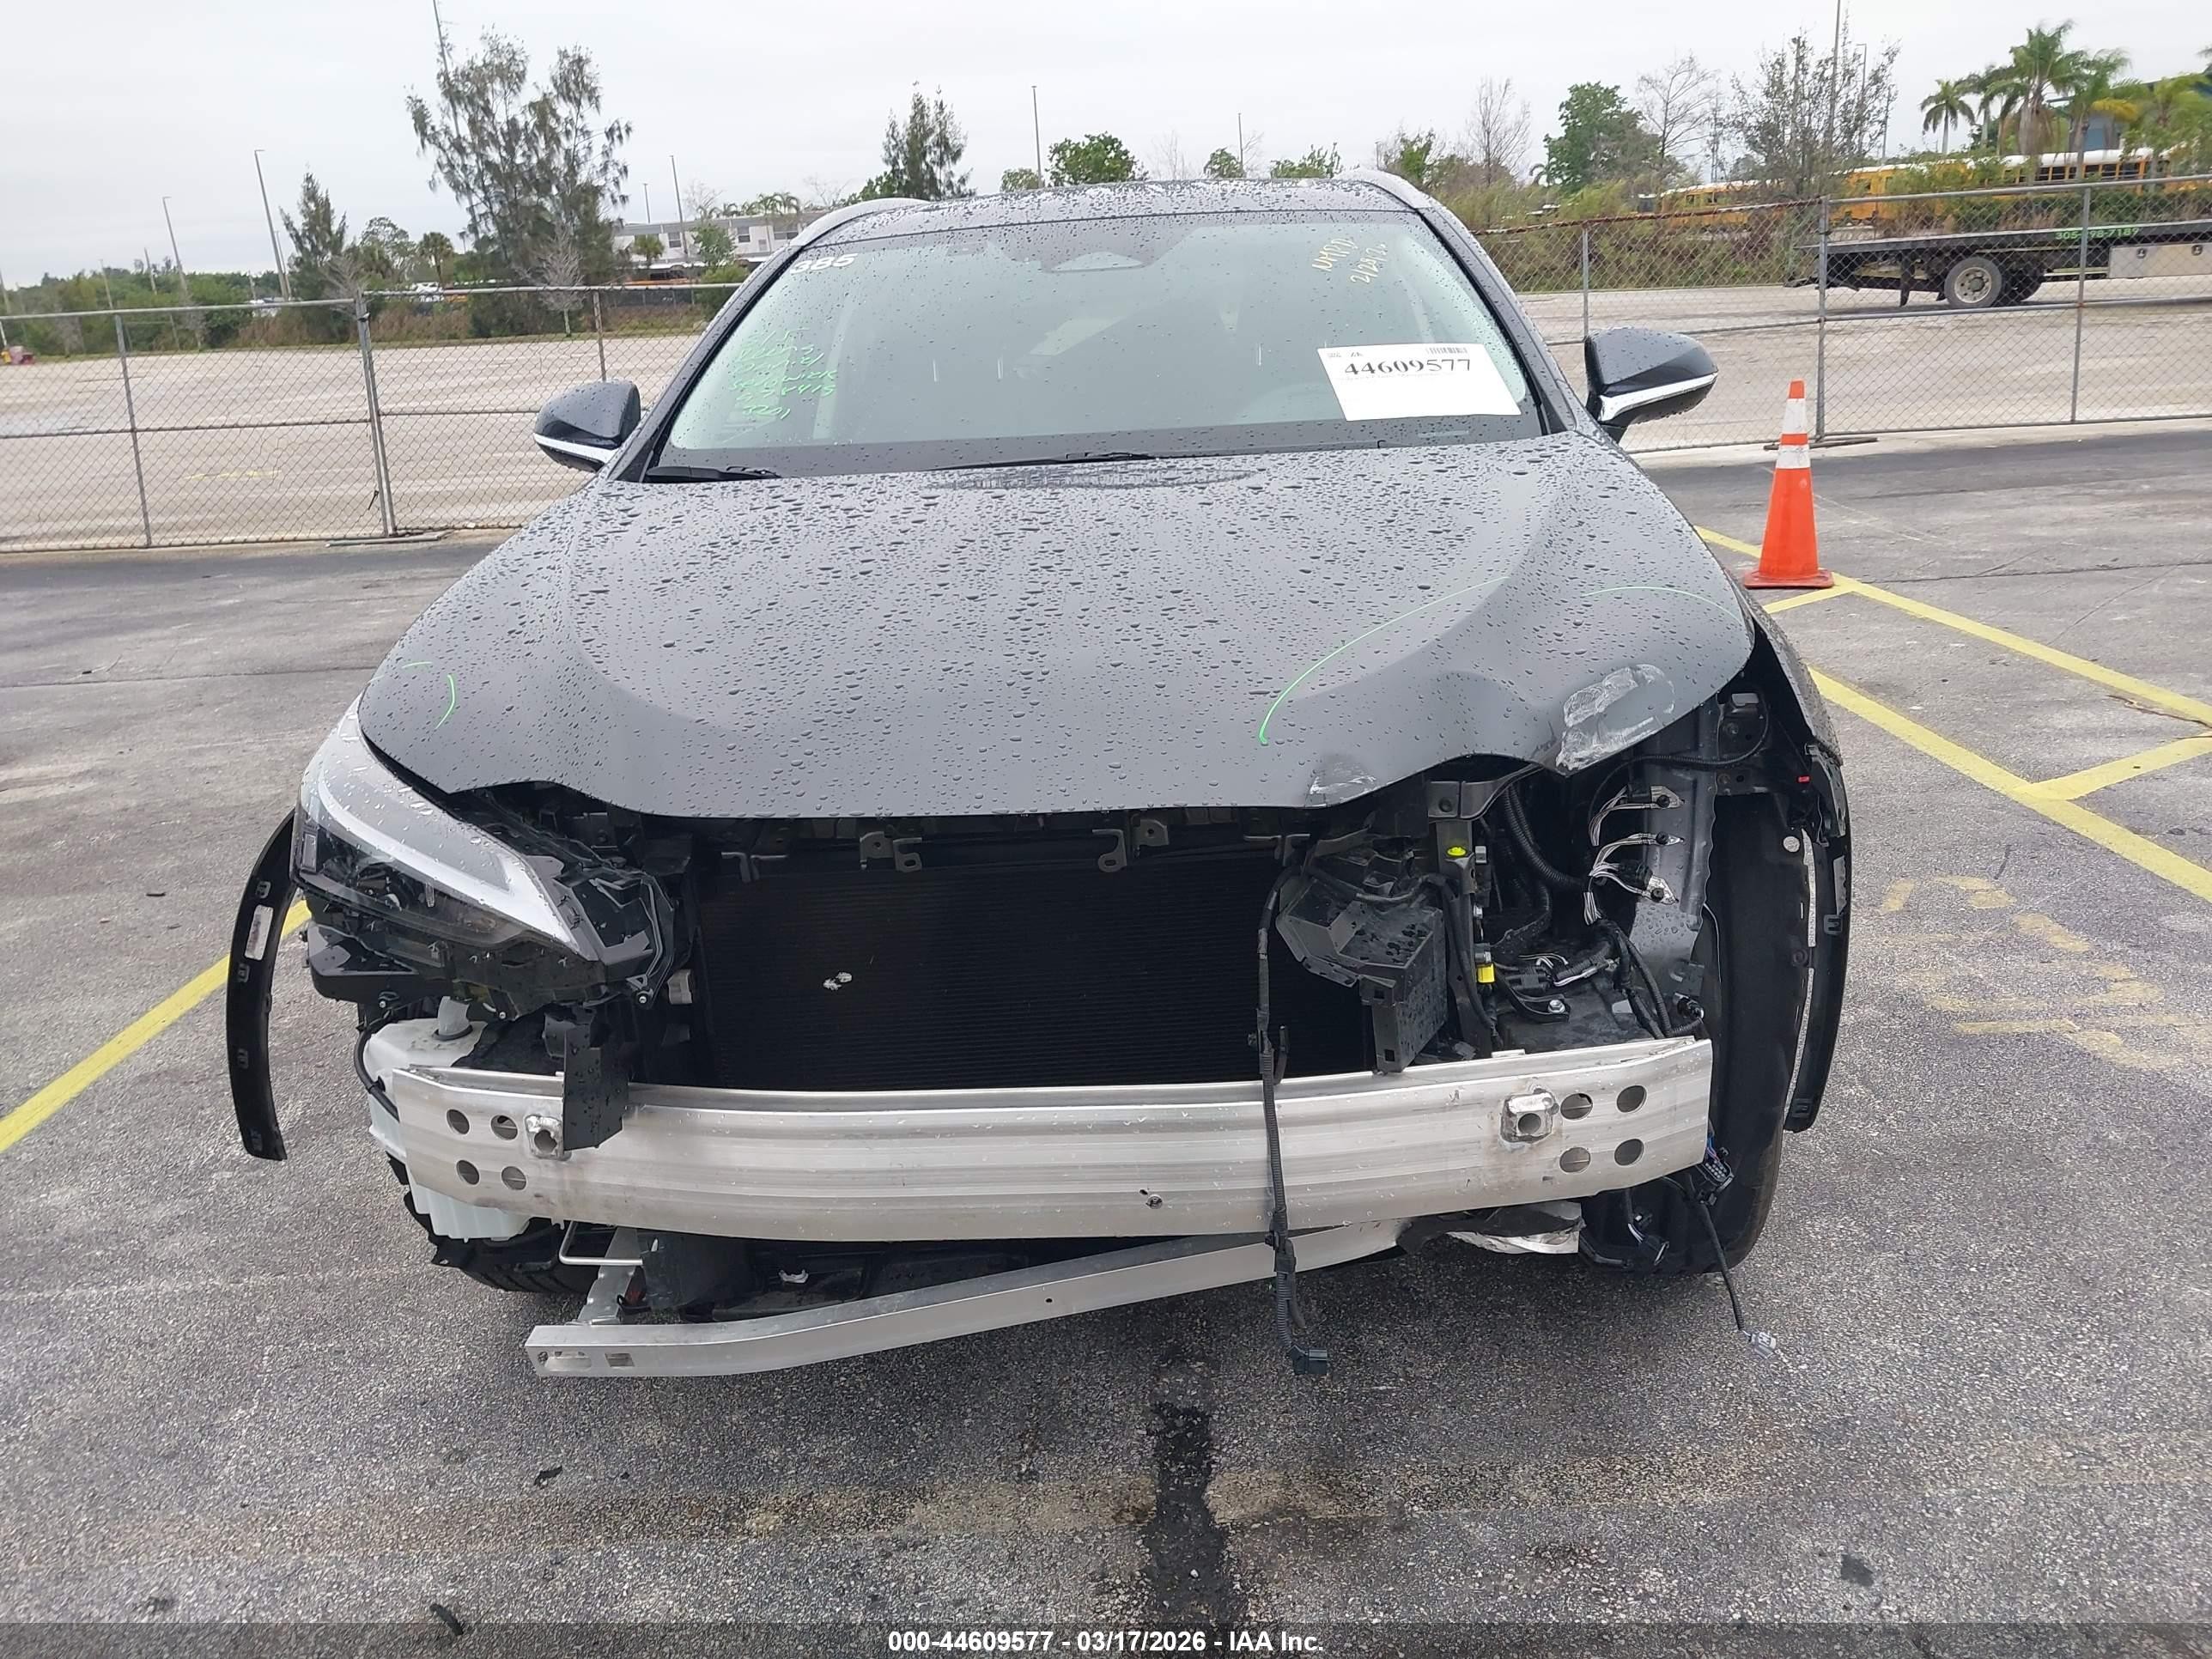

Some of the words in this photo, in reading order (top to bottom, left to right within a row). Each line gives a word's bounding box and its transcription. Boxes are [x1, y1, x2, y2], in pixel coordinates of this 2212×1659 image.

[2055, 228, 2139, 240] 305-98-7189
[790, 252, 858, 274] 385
[1344, 359, 1471, 375] 44609577
